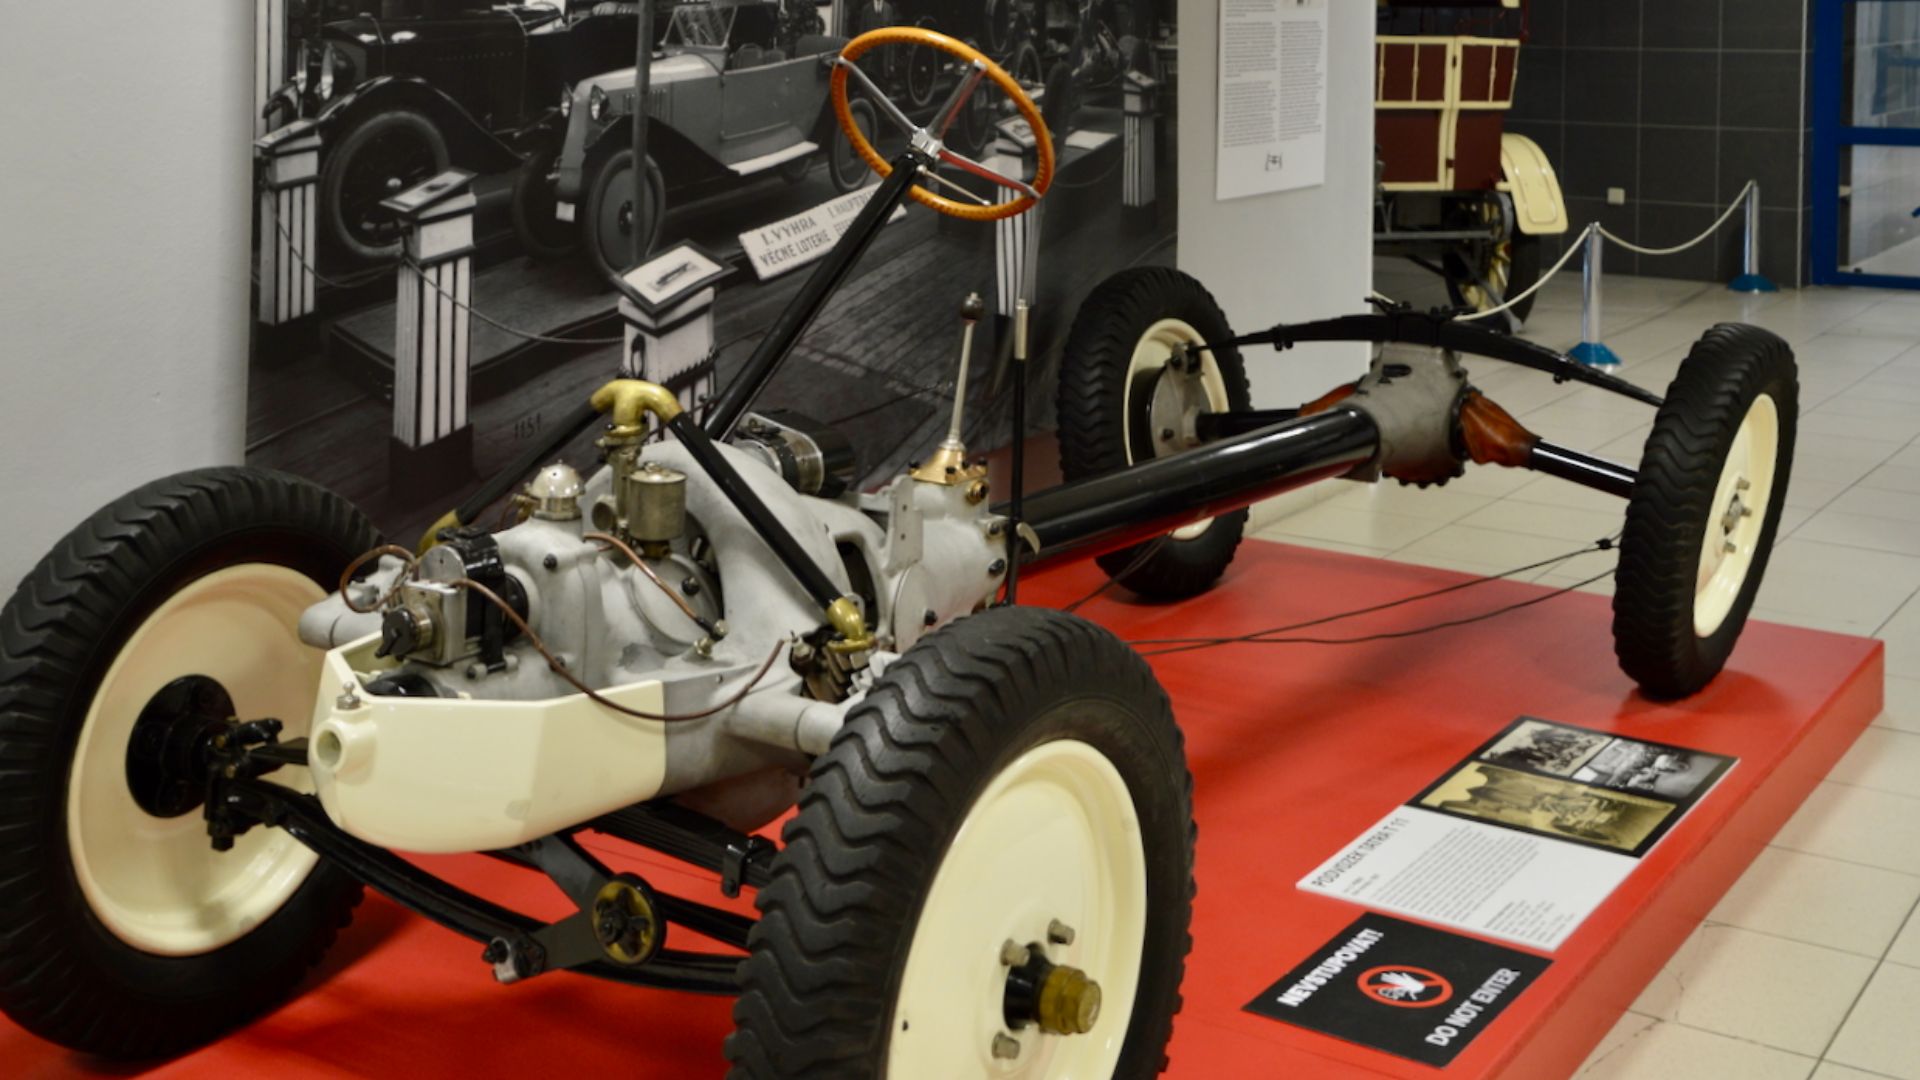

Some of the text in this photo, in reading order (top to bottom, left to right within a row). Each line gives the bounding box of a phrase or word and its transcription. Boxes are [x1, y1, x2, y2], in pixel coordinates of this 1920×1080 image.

[770, 215, 818, 241] VYHRA
[795, 228, 832, 255] LOTERIE
[1311, 850, 1366, 887] PODVOZEK
[1357, 830, 1393, 853] TATRA
[1276, 927, 1384, 1007] NEVSTUPOVAT!
[1424, 967, 1521, 1047] DO NOT ENTER
